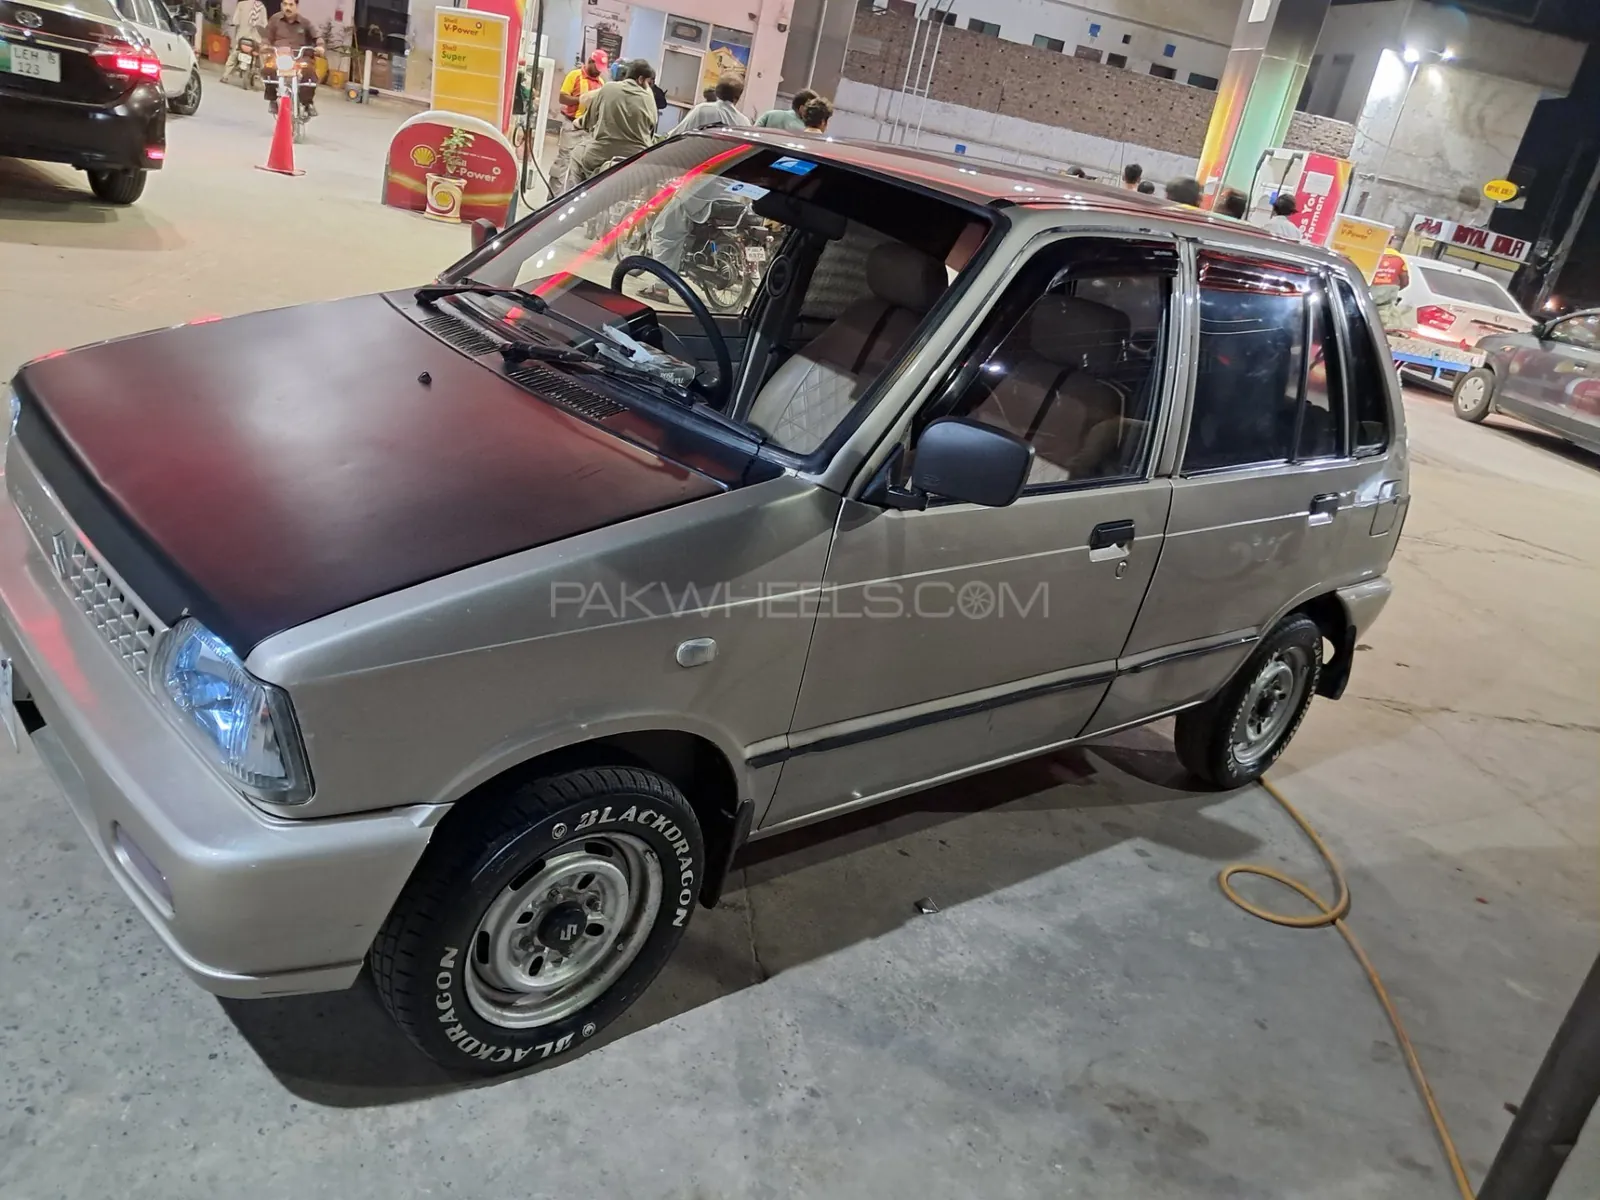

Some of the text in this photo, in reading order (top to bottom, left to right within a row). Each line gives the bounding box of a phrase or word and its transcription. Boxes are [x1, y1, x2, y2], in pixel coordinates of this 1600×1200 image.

[444, 23, 479, 37] V-Power
[441, 50, 467, 63] Super
[18, 61, 40, 75] 123
[574, 806, 695, 928] BLACKDRAGON
[435, 946, 576, 1063] BLACKDRAGON
